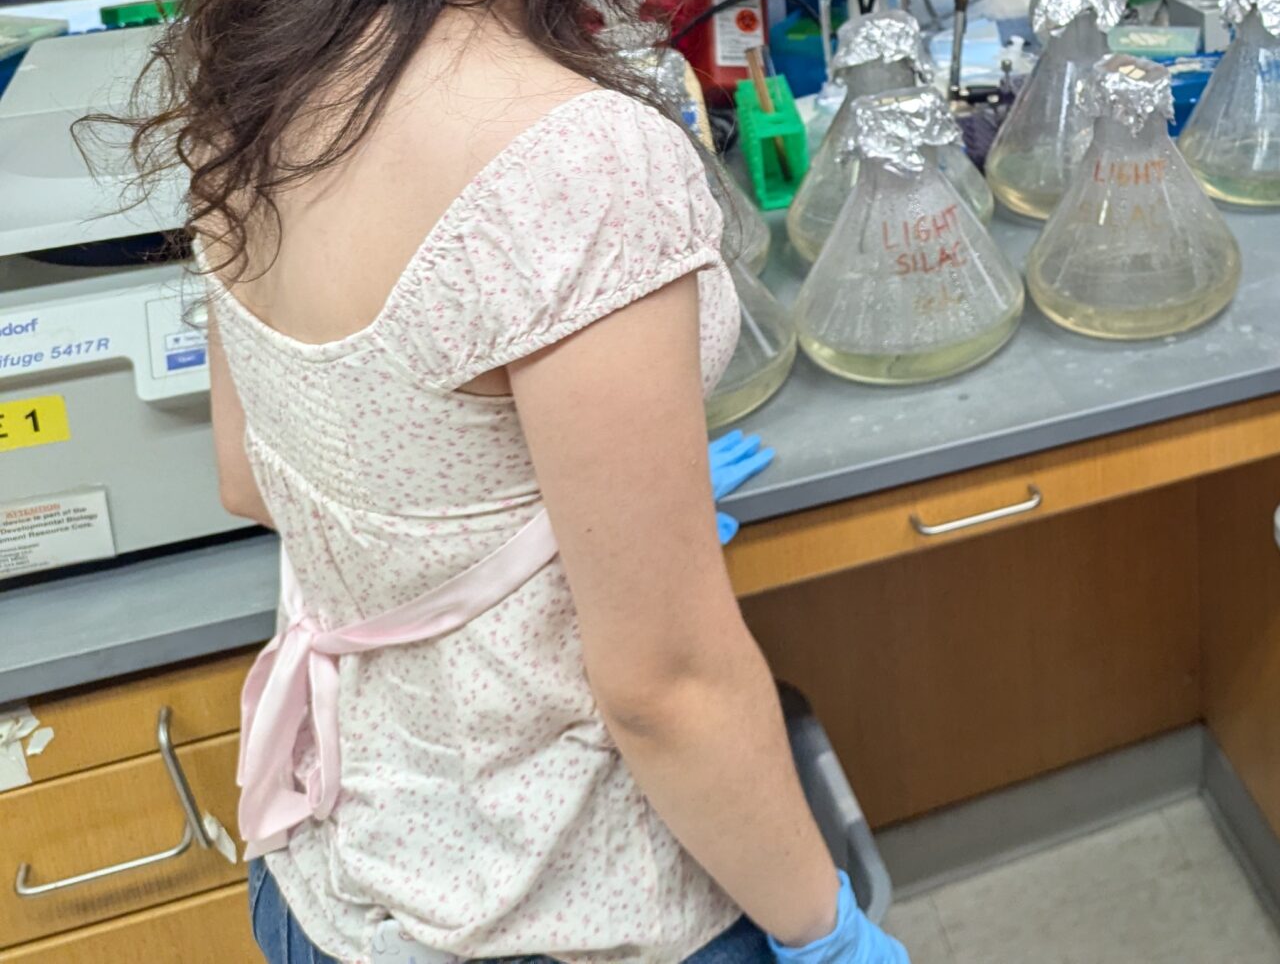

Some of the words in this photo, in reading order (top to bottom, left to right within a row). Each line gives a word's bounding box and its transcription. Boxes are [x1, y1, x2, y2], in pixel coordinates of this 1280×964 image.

[1093, 158, 1168, 188] LIGHT
[881, 203, 958, 252] LIGHT
[896, 241, 968, 276] SILAC
[0, 317, 39, 337] dorf
[25, 408, 40, 433] 1
[3, 517, 31, 527] device
[43, 511, 61, 521] part
[62, 508, 71, 516] of
[5, 503, 61, 519] ATTENTION
[0, 519, 65, 535] Developmental
[66, 513, 98, 524] Biology
[28, 526, 70, 538] Resource
